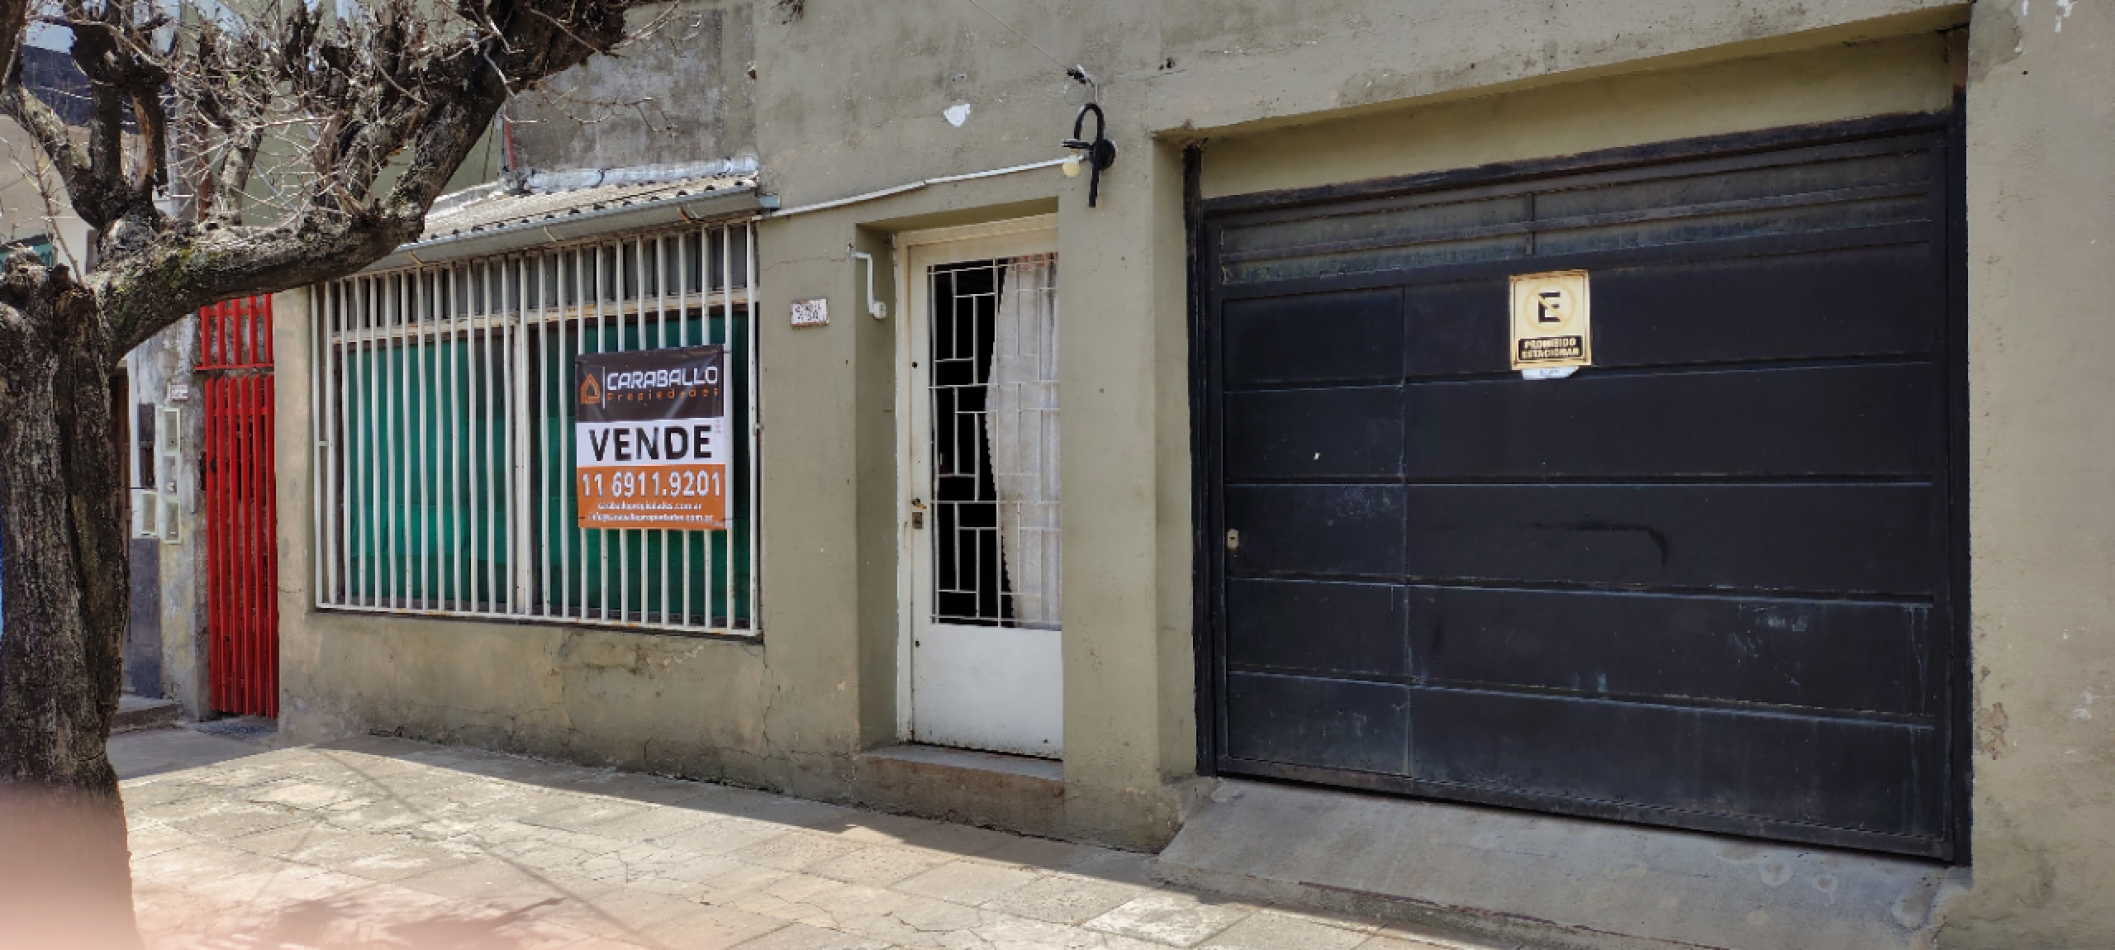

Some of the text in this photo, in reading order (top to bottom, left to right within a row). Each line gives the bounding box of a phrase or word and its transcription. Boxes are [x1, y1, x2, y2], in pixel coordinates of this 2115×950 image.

[1521, 346, 1580, 359] ESTACIONAR
[1524, 337, 1577, 349] PROHIBIDO
[607, 366, 718, 390] CARABALLO
[589, 425, 712, 461] VENDE
[582, 469, 720, 498] 11 6911.9201
